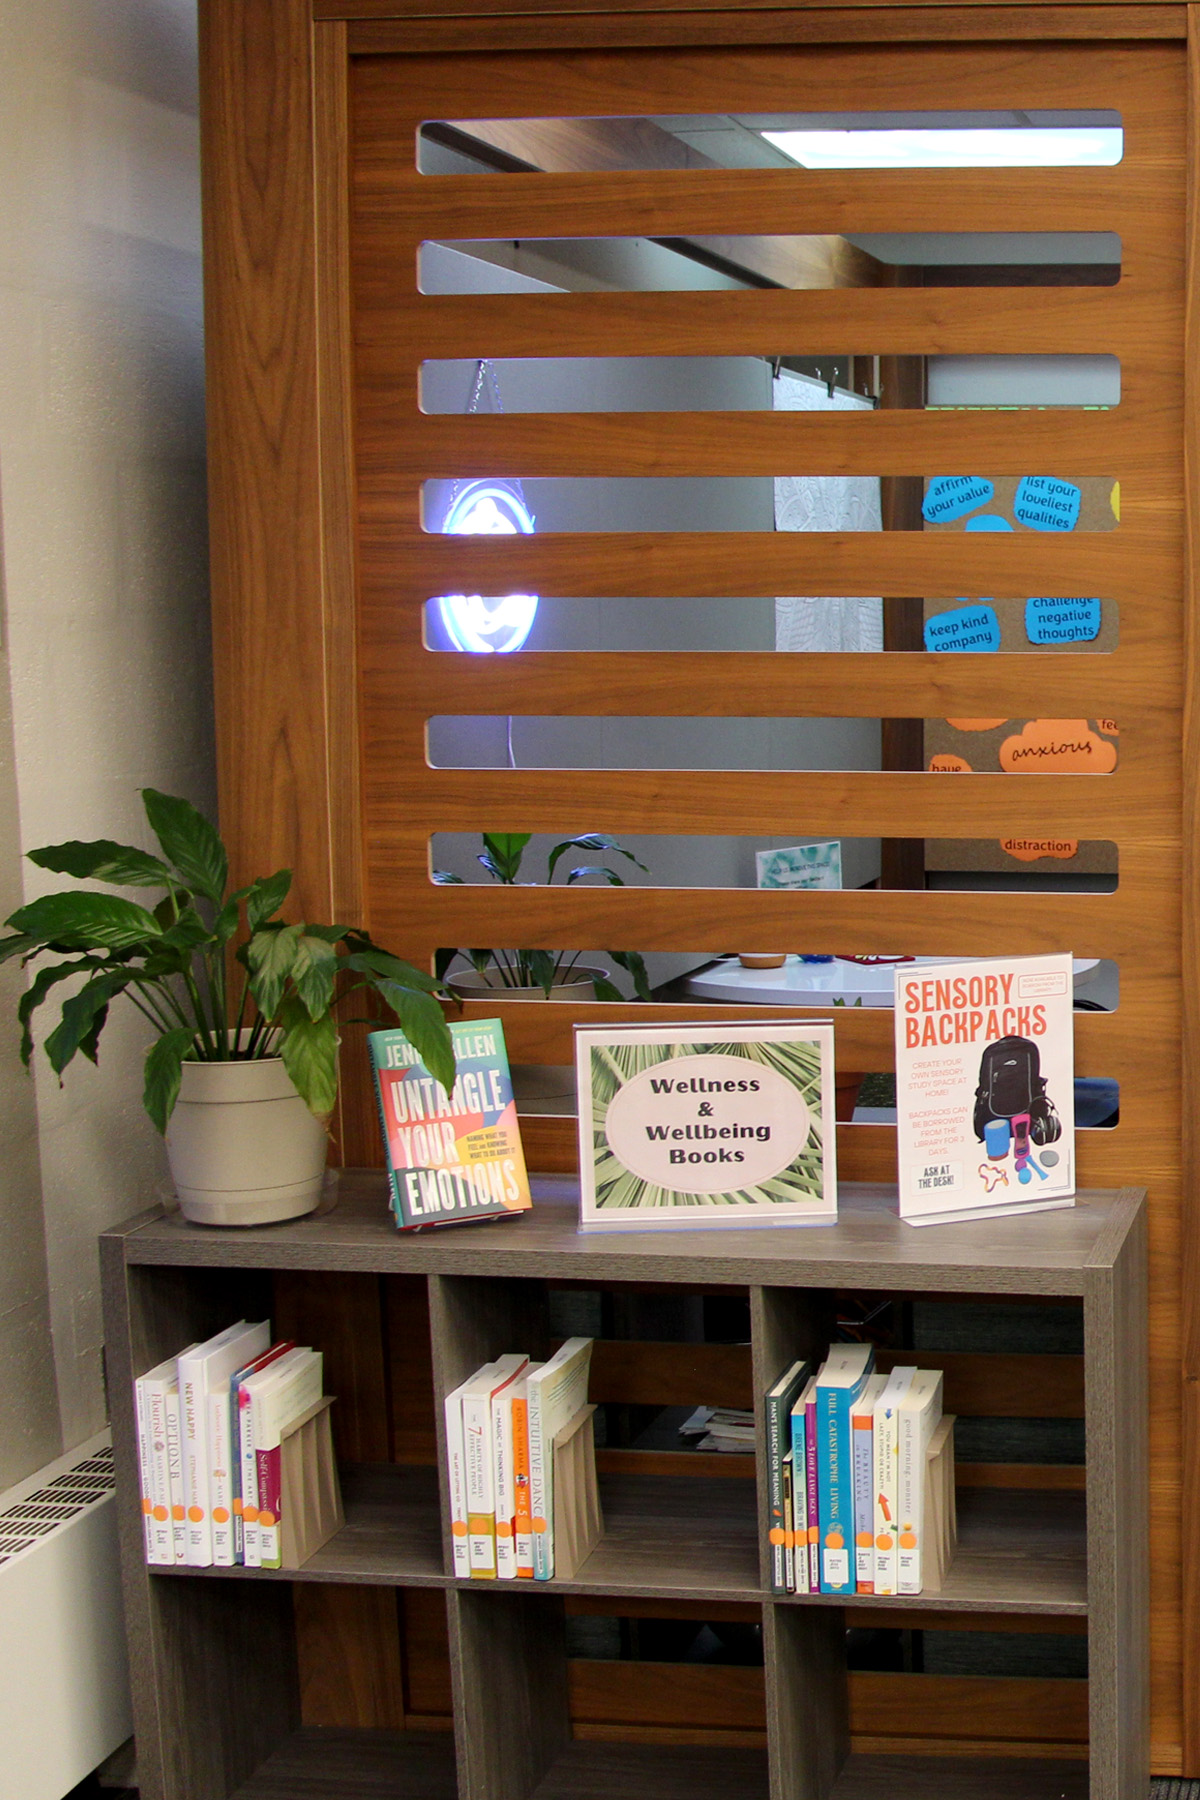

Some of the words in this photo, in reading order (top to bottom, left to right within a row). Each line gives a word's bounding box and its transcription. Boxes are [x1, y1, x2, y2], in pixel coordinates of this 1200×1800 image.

[934, 476, 973, 496] affirm
[1026, 476, 1045, 489] list
[1048, 482, 1077, 497] your
[927, 499, 955, 518] your
[957, 484, 990, 503] value
[1022, 491, 1073, 513] loveliest
[1017, 507, 1070, 529] qualities
[929, 622, 959, 637] keep
[961, 614, 989, 628] kind
[1038, 609, 1092, 625] negative
[934, 632, 993, 652] company
[1038, 625, 1095, 640] thoughts
[1012, 741, 1092, 761] anxious
[1005, 839, 1071, 852] distraction
[905, 973, 1014, 1014] SENSORY
[905, 1004, 1047, 1049] BACKPACKS
[912, 1060, 940, 1069] CREATE
[943, 1058, 962, 1066] YOUR
[931, 1068, 963, 1077] SENSORY
[650, 1078, 760, 1094] Wellness
[908, 1081, 931, 1089] STUDY
[933, 1078, 956, 1087] SPACE
[390, 1069, 506, 1124] UNTANGLE
[698, 1101, 714, 1117] &
[909, 1108, 951, 1119] BACKPACKS
[923, 1116, 965, 1127] BORROWED
[646, 1123, 771, 1142] Wellbeing
[397, 1121, 460, 1169] YOUR
[914, 1140, 942, 1148] LIBRARY
[669, 1148, 745, 1164] Books
[923, 1167, 939, 1177] ASK
[940, 1165, 950, 1175] AT
[405, 1159, 520, 1216] EMOTIONS
[918, 1178, 932, 1189] THE
[934, 1175, 954, 1188] DESK!
[185, 1382, 194, 1406] NEW
[530, 1390, 538, 1403] the
[828, 1392, 837, 1416] FULL
[152, 1393, 164, 1438] Flourish
[186, 1408, 196, 1440] HAPPY
[516, 1407, 524, 1434] ROBIN
[468, 1426, 482, 1436] 7
[904, 1419, 913, 1438] good
[167, 1414, 178, 1468] OPTION
[530, 1406, 542, 1473] INTUITIVE
[771, 1425, 779, 1454] SEARCH
[828, 1419, 838, 1483] CATASTROPHE
[904, 1441, 913, 1478] morning,
[497, 1450, 505, 1483] THINKING
[771, 1455, 779, 1470] FOR
[879, 1458, 884, 1466] OR
[171, 1471, 180, 1479] B
[259, 1454, 270, 1511] Self-Compassi
[533, 1478, 544, 1518] DANC
[772, 1472, 780, 1506] MEANING
[830, 1487, 840, 1519] LIVING
